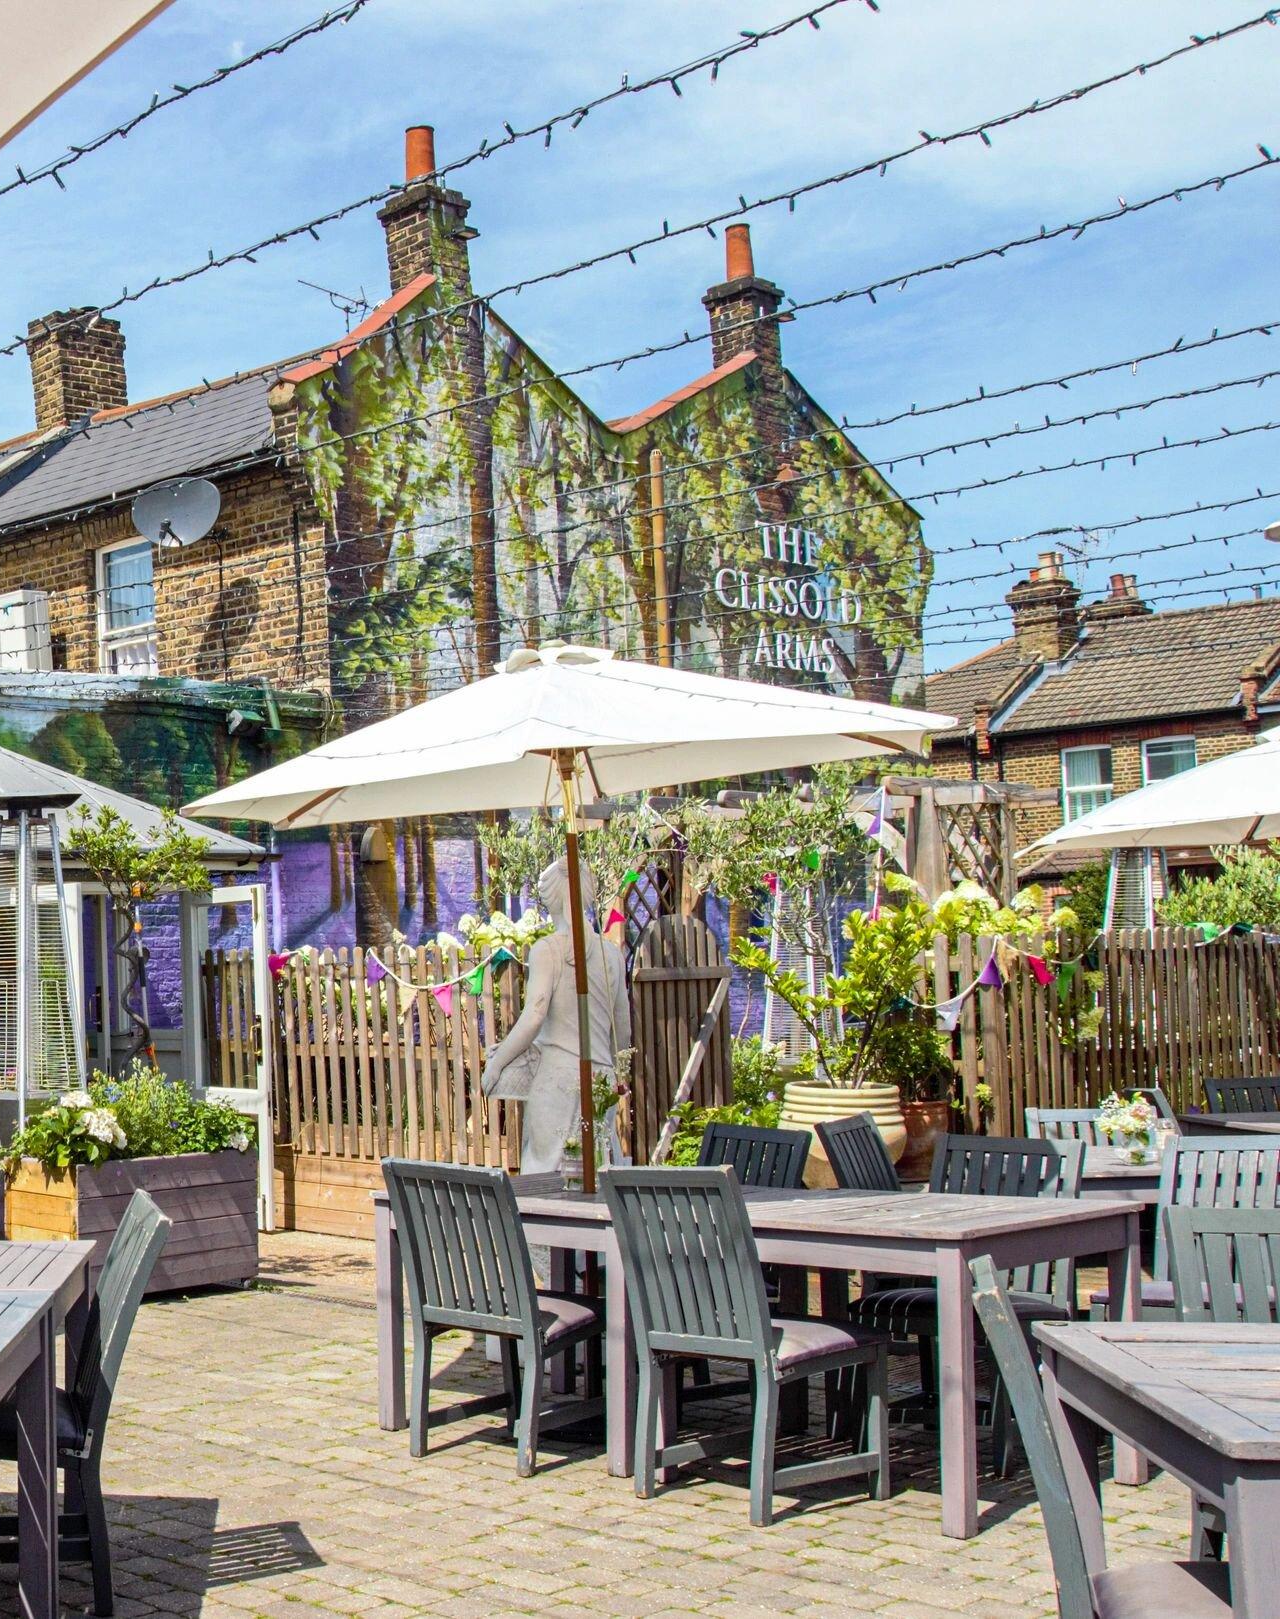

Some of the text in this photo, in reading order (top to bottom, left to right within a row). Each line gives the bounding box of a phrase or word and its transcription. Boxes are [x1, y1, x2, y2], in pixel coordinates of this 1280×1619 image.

[755, 520, 822, 567] THE
[715, 568, 863, 625] CLISSOLD
[754, 628, 838, 674] ARMS
